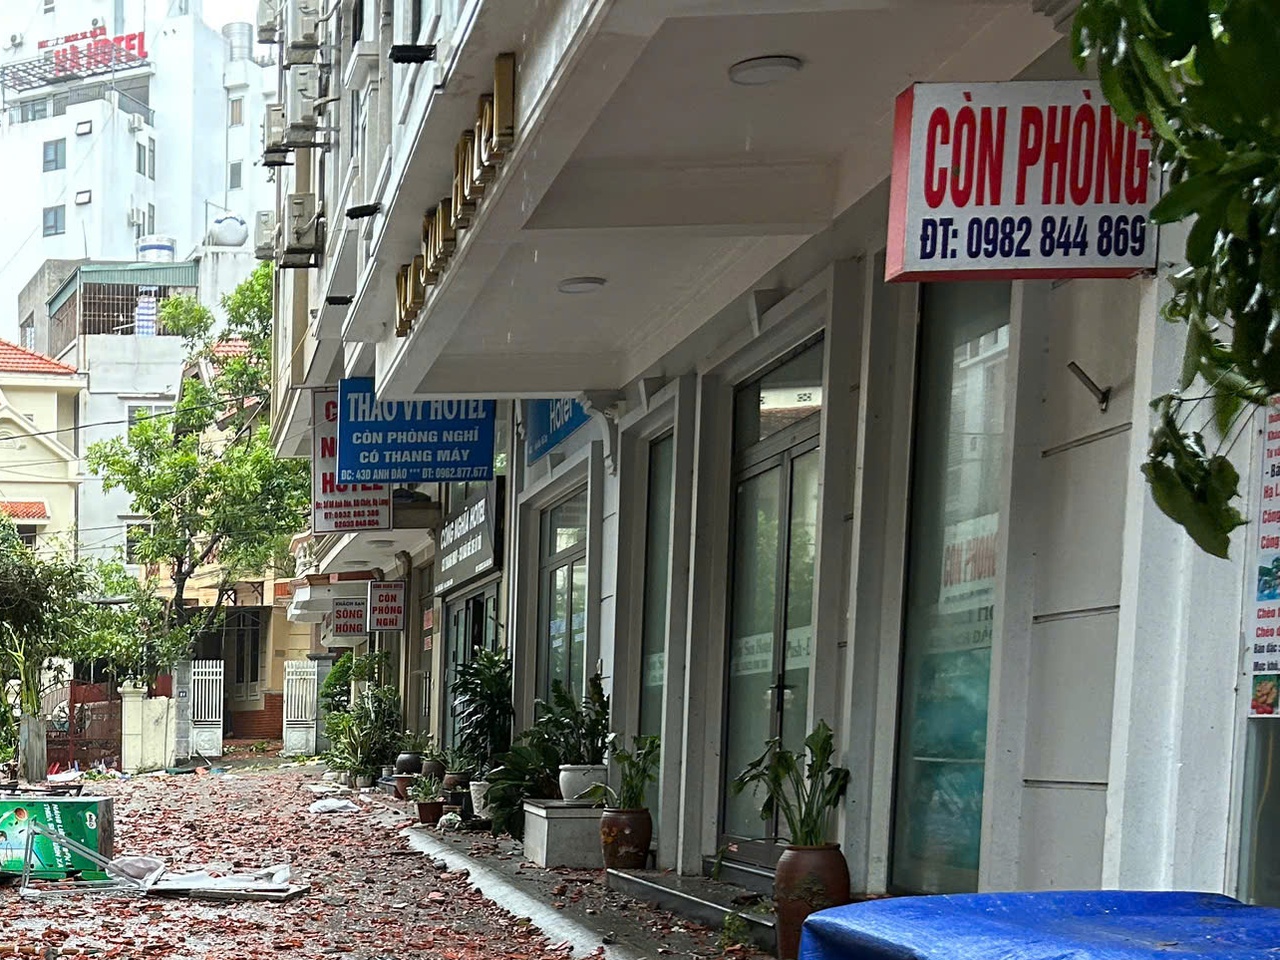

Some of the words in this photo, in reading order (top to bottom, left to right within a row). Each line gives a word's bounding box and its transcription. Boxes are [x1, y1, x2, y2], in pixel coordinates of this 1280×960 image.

[923, 91, 1007, 208] CÒN
[1015, 89, 1152, 206] PHÒNG
[919, 218, 958, 260] ĐT:
[966, 216, 1033, 258] 0982
[1039, 215, 1089, 257] 844
[1097, 214, 1145, 257] 869
[352, 429, 383, 444] CÒN
[387, 428, 438, 443] PHÒNG
[442, 426, 479, 442] NGHỈ
[359, 449, 379, 464] CÓ
[383, 451, 432, 463] THANG
[436, 448, 470, 462] MÁY
[372, 468, 389, 480] ANH
[378, 592, 397, 603] CÒN
[335, 607, 363, 619] SÔNG
[372, 604, 402, 615] PHÒNG
[376, 615, 398, 627] NGHỈ
